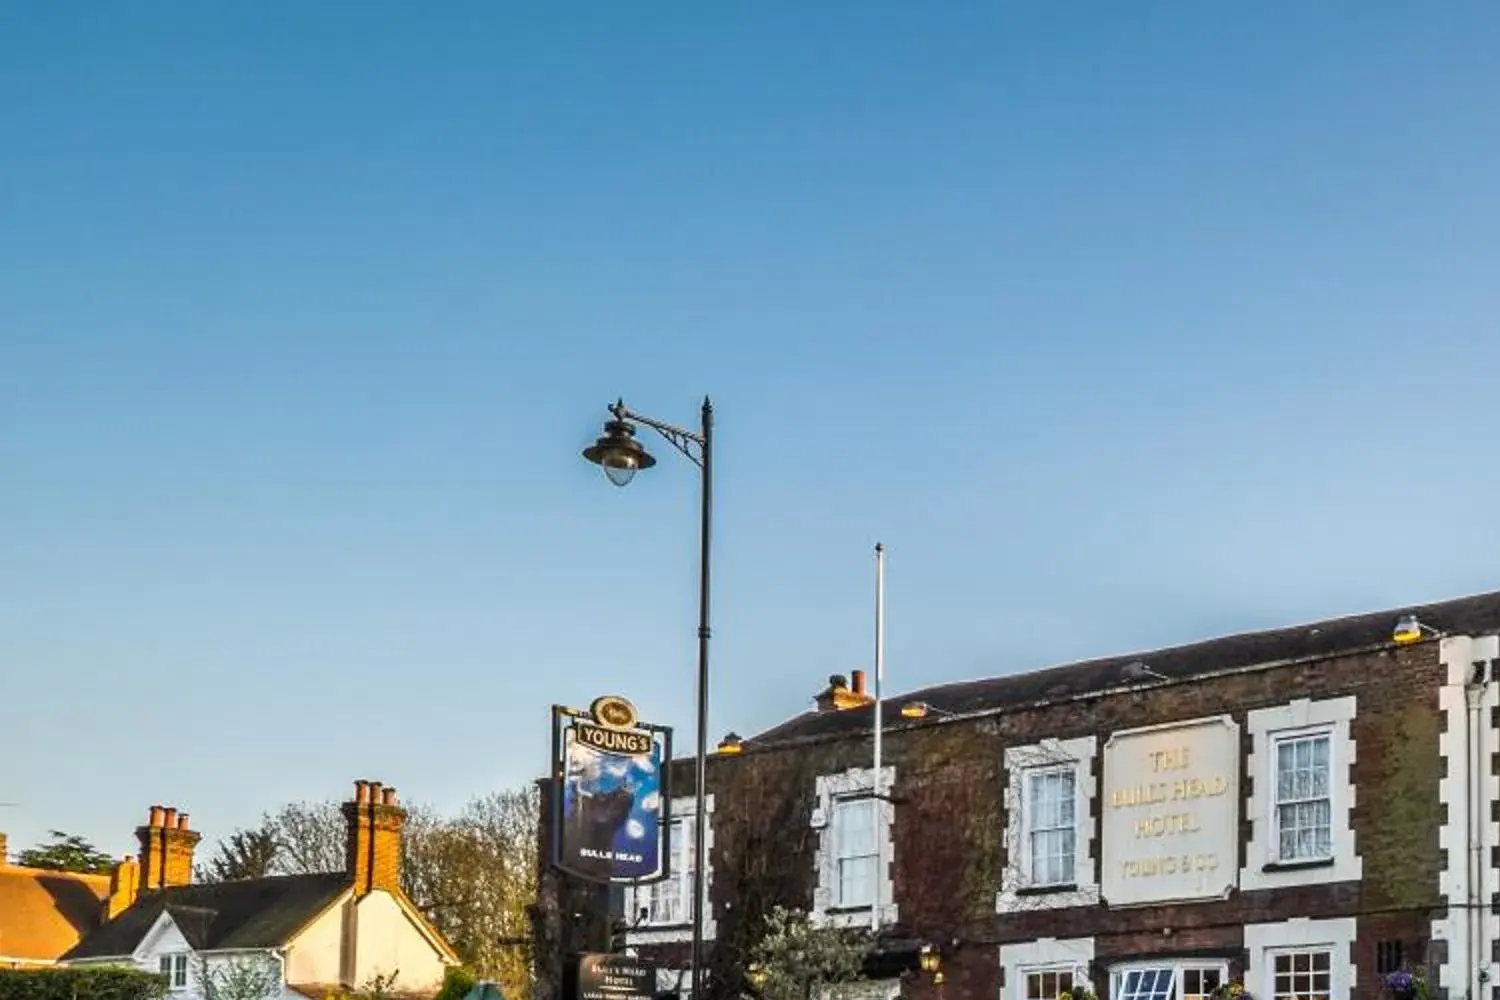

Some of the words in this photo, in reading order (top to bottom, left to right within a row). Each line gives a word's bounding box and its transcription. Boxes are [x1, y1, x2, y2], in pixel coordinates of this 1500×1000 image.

[585, 727, 649, 751] YOUNG'S
[1148, 749, 1191, 773] THE
[1171, 776, 1227, 802] HEAD
[1133, 813, 1202, 840] HOTEL
[615, 851, 644, 863] HEAD
